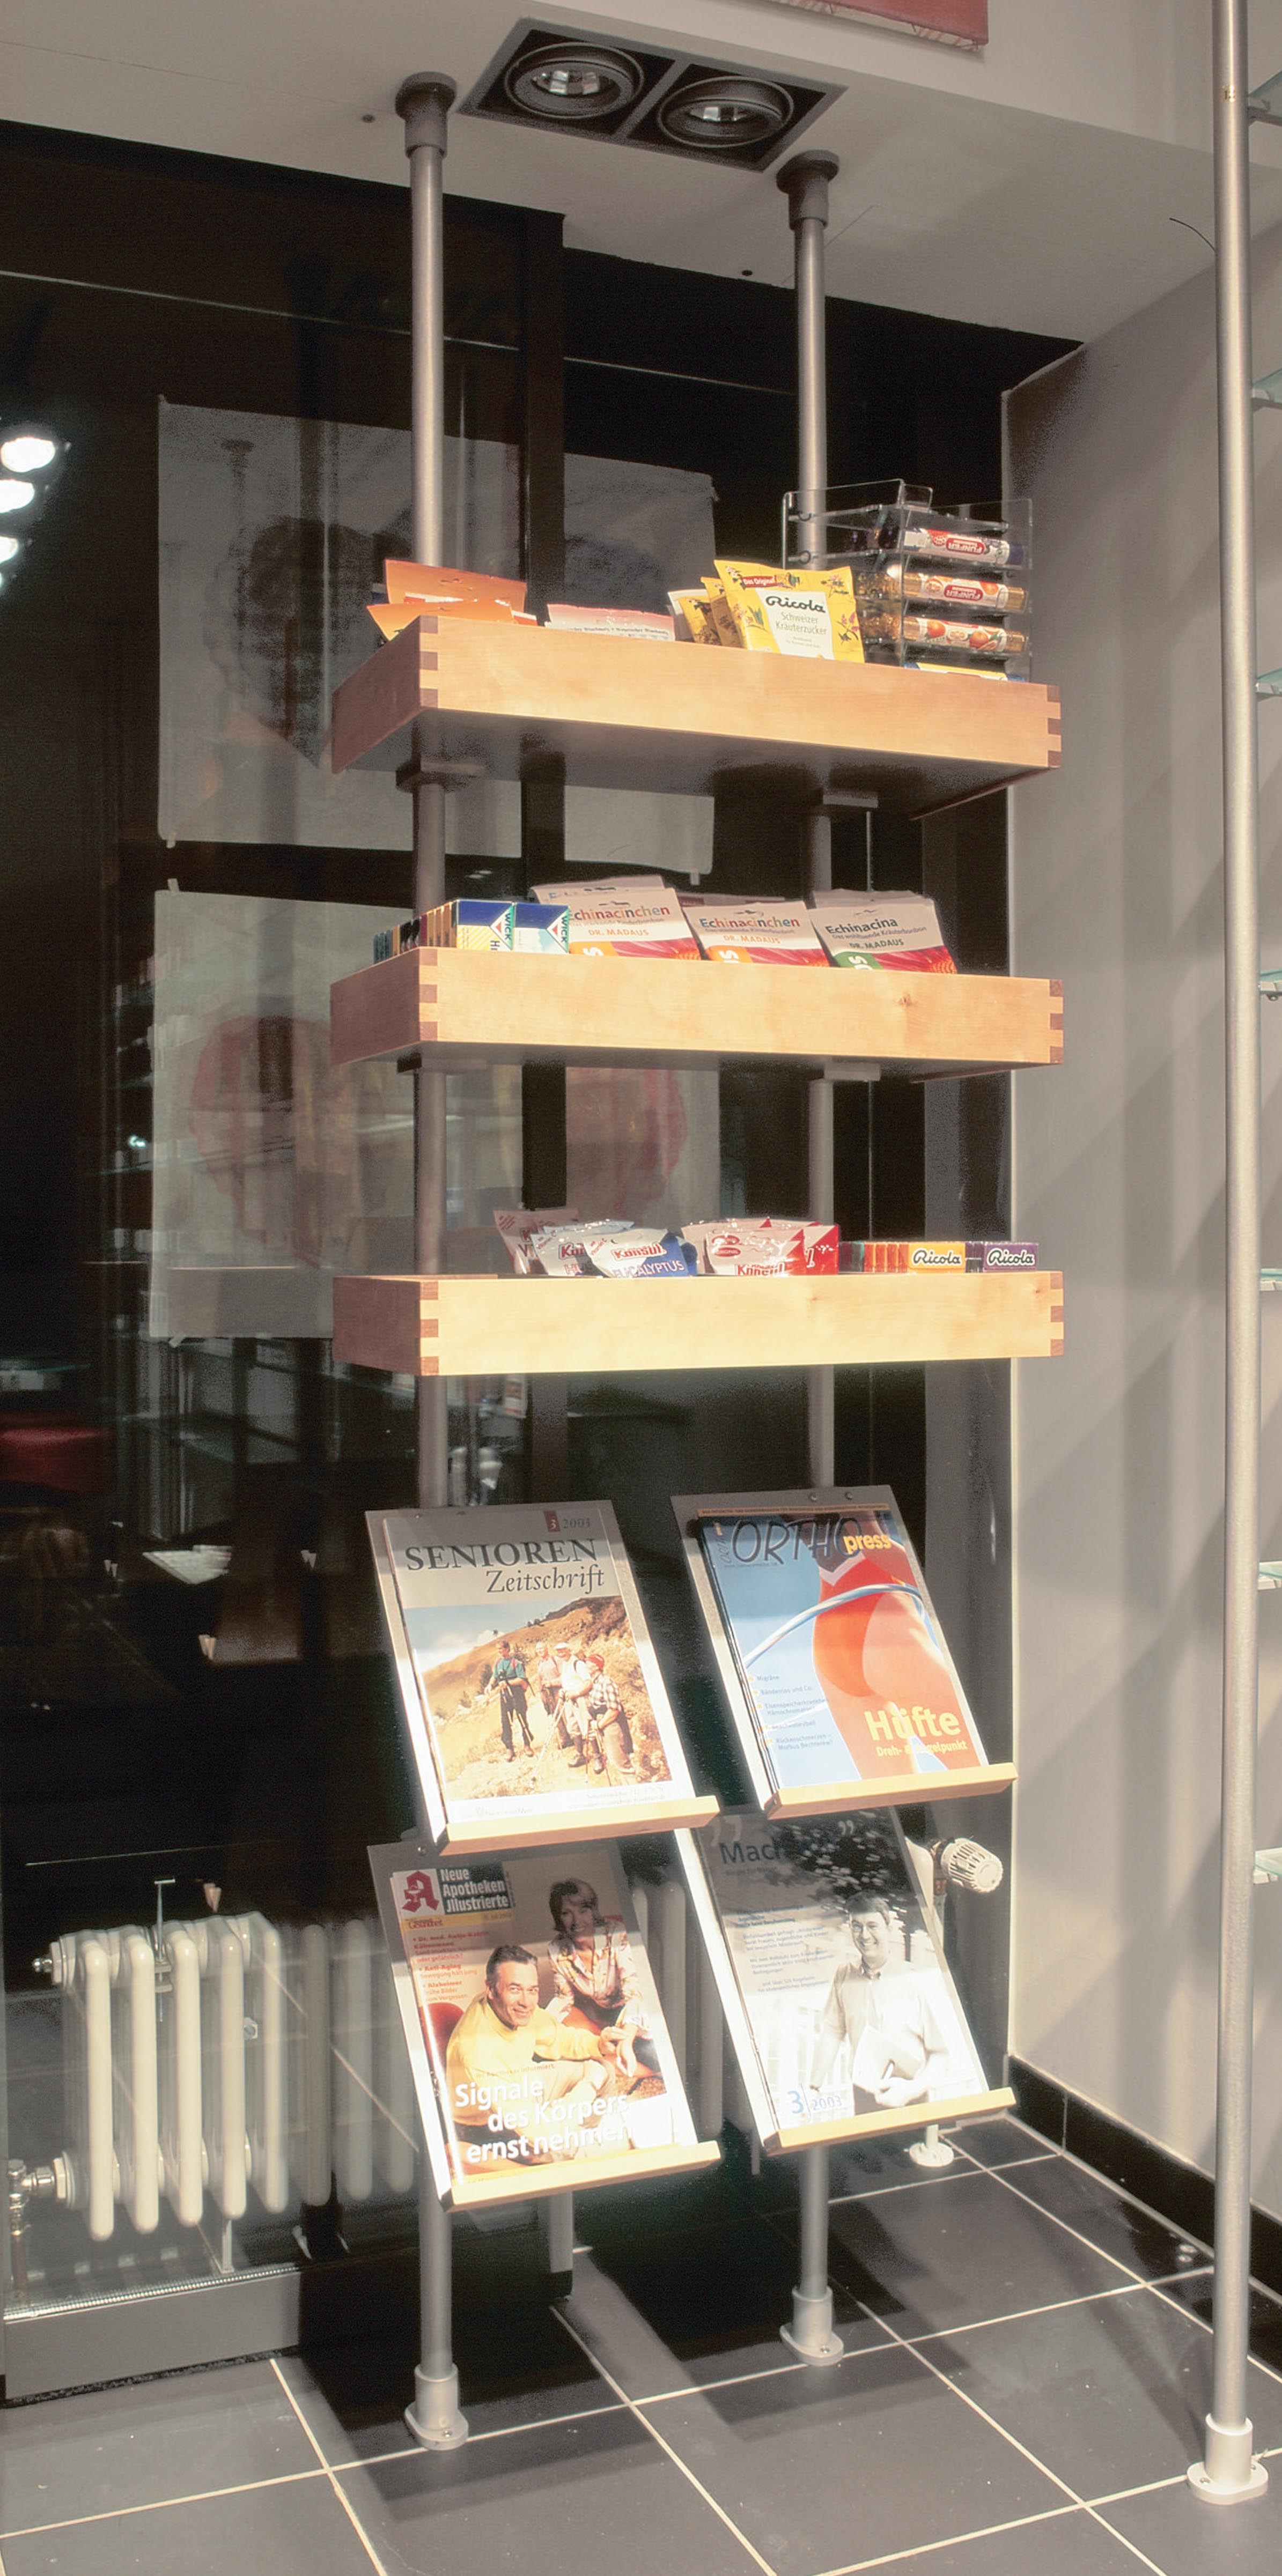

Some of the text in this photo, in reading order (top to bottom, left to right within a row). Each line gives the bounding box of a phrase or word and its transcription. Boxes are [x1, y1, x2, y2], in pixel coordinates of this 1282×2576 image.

[765, 595, 827, 614] Ricola
[781, 611, 819, 625] Schweizer
[776, 620, 828, 635] Kräuterzucker
[699, 916, 800, 928] Echinacinchen
[824, 917, 898, 935] Echinacina
[606, 929, 650, 937] MADAUS
[741, 935, 780, 944] MADAUS
[865, 938, 904, 949] MADAUS
[913, 1248, 962, 1265] Ricola
[988, 1248, 1034, 1264] Ricola
[731, 1517, 892, 1565] ORTHO press
[405, 1538, 598, 1572] SENIOREN
[485, 1564, 605, 1595] Zeitschrift
[864, 1706, 961, 1741] Hüfte
[875, 1744, 903, 1757] Dreh-
[440, 1868, 469, 1882] Neue
[442, 1879, 506, 1898] Apotheken
[455, 2075, 544, 2111] Signale
[787, 2090, 843, 2114] 3 2003
[488, 2094, 628, 2133] des Körpers
[467, 2122, 634, 2164] ernst nehmen
